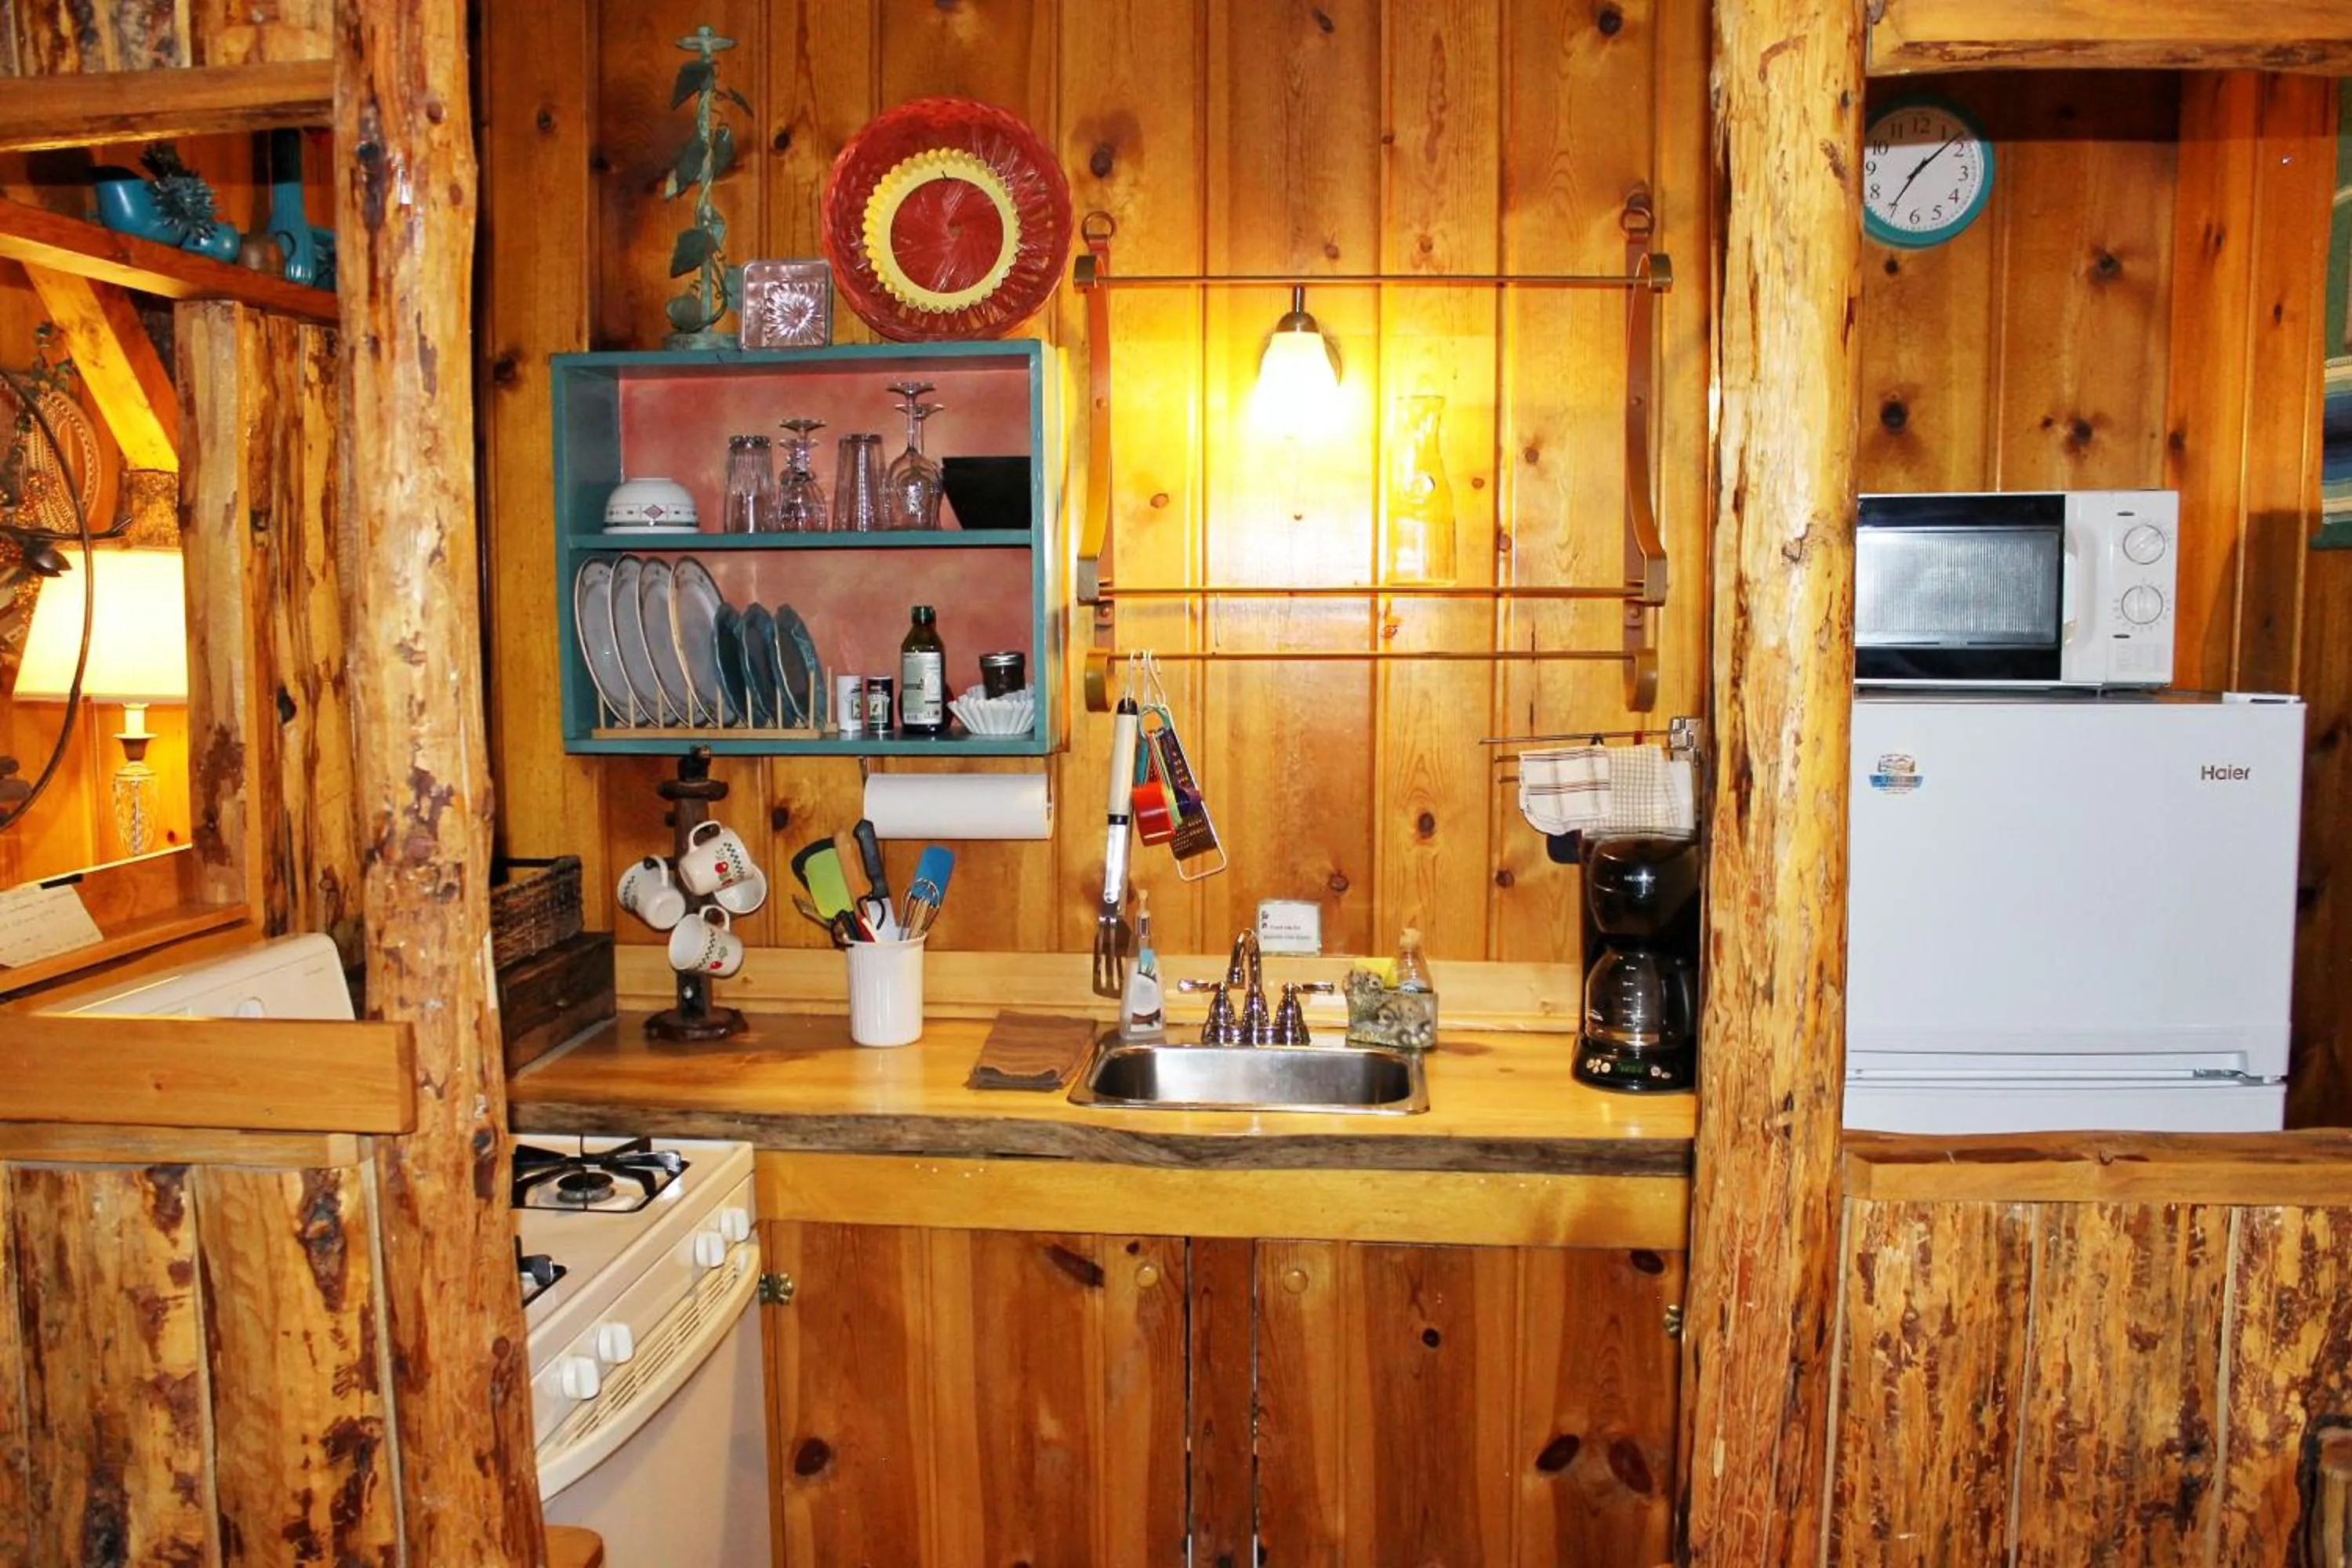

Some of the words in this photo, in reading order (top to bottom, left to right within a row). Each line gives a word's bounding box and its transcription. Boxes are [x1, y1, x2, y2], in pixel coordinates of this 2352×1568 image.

[1891, 123, 1904, 139] 11
[1912, 118, 1932, 134] 12
[1940, 124, 1947, 140] 1
[1872, 139, 1889, 156] 10
[1954, 142, 1965, 158] 2
[1865, 161, 1877, 176] 9
[1958, 165, 1969, 181] 3
[1870, 183, 1881, 199] 8
[1947, 187, 1960, 204] 4
[1888, 202, 1898, 219] 7
[1909, 207, 1921, 225] 6
[1931, 205, 1943, 221] 5
[2201, 764, 2251, 780] Haier
